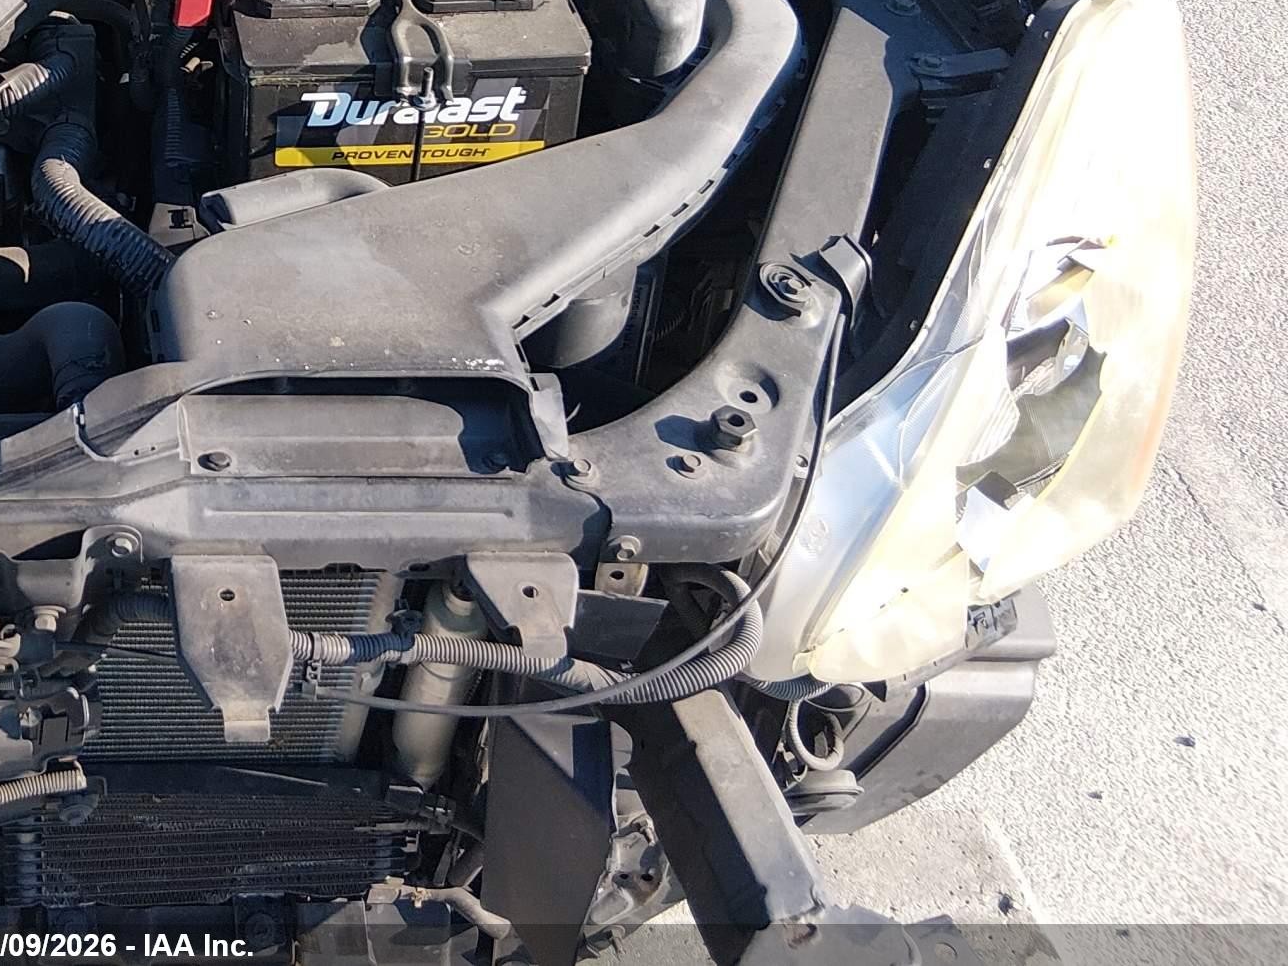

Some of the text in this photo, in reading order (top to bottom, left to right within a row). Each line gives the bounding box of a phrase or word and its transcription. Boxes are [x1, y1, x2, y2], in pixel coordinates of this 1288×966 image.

[423, 122, 516, 139] GOLD
[331, 147, 489, 161] PROVEN TOUGH
